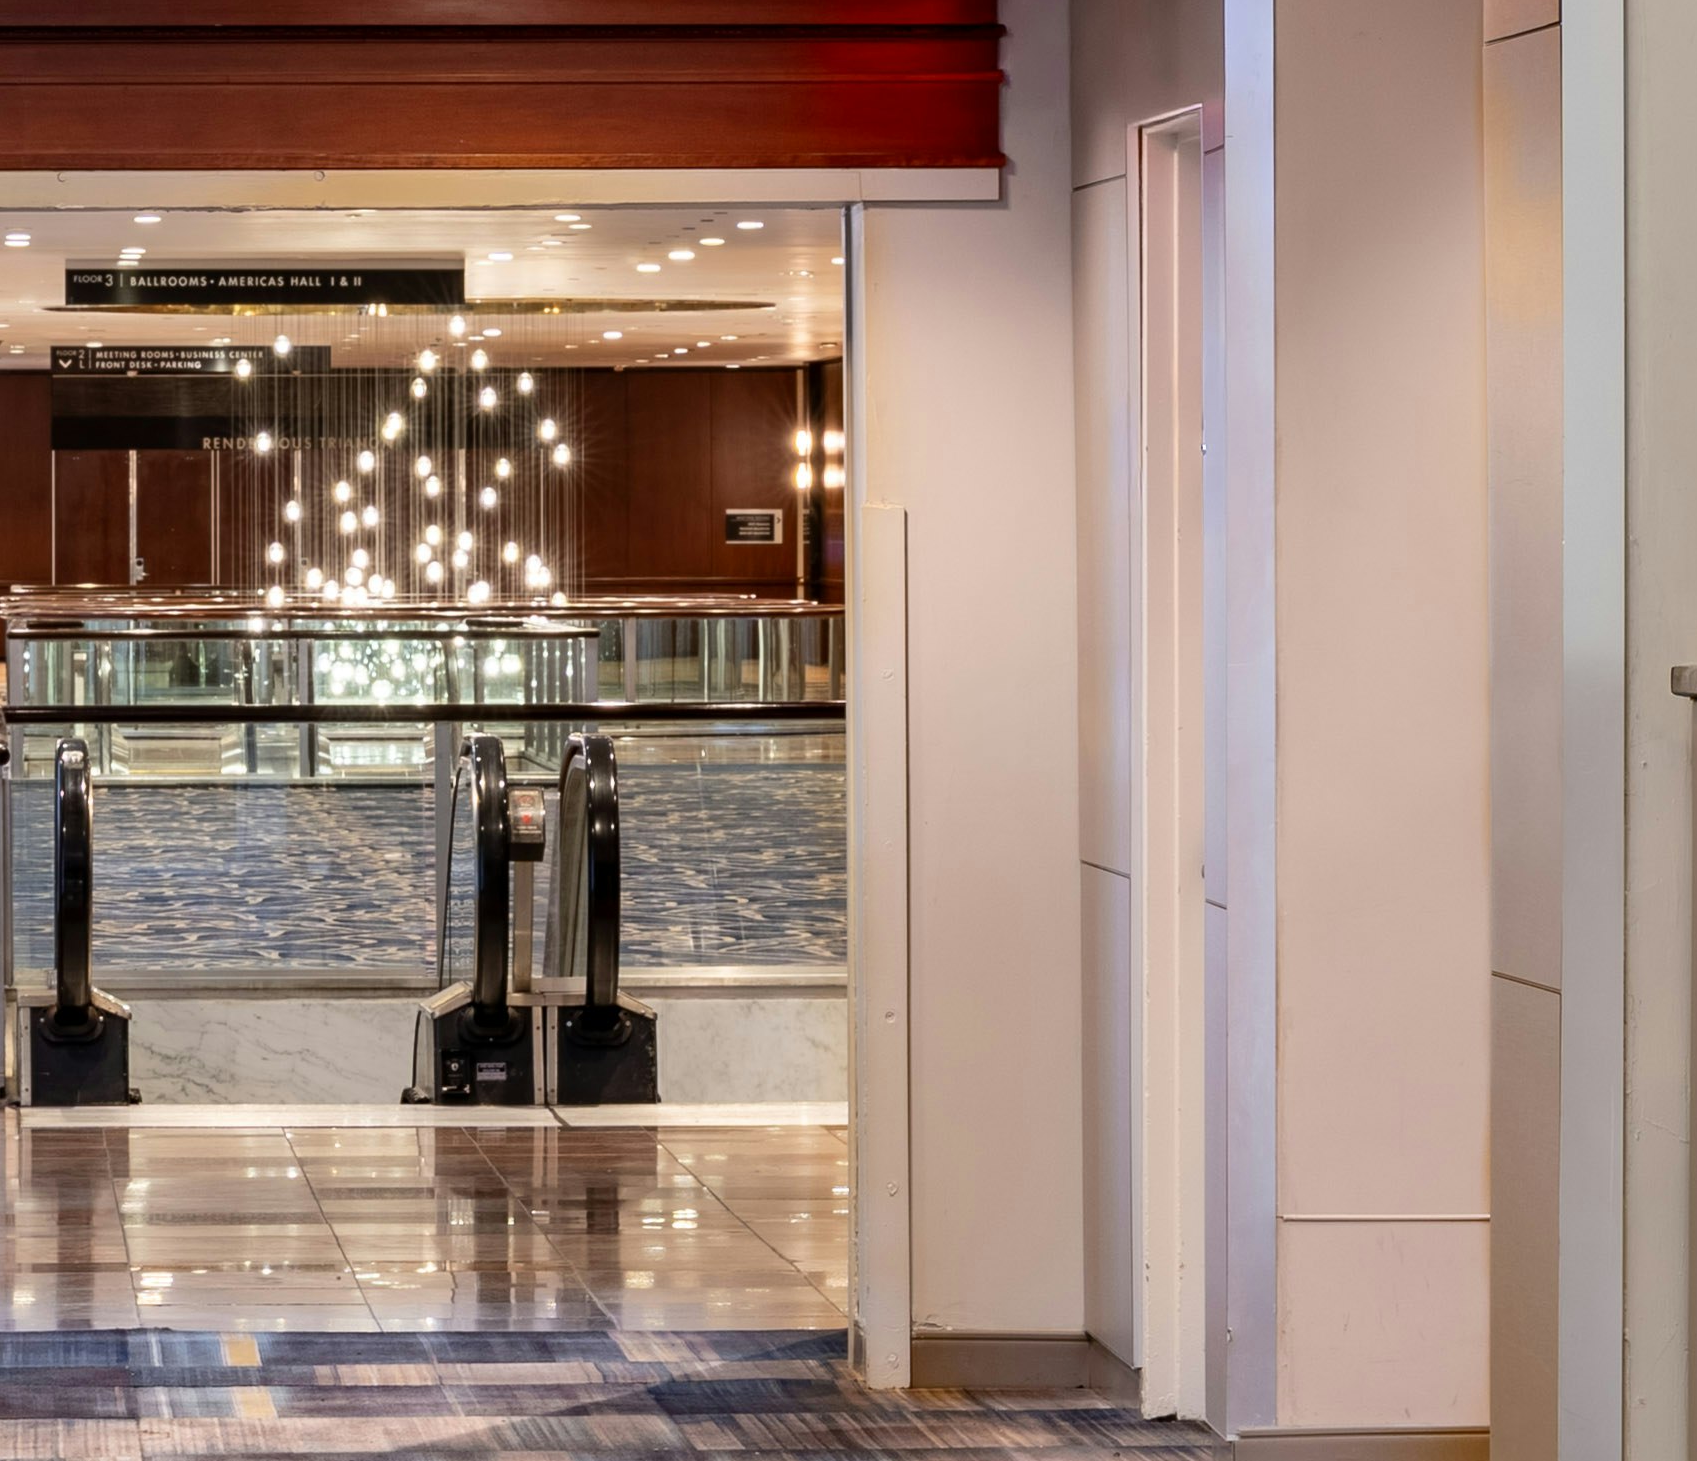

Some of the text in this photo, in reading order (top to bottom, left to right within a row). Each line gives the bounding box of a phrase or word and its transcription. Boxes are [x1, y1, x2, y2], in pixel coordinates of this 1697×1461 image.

[73, 274, 362, 287] FLOOR 3 BALLROOMS AMERICAS HALL I & II
[78, 350, 85, 358] 2
[160, 361, 202, 369] PARKING
[202, 437, 312, 450] RENDEOUS
